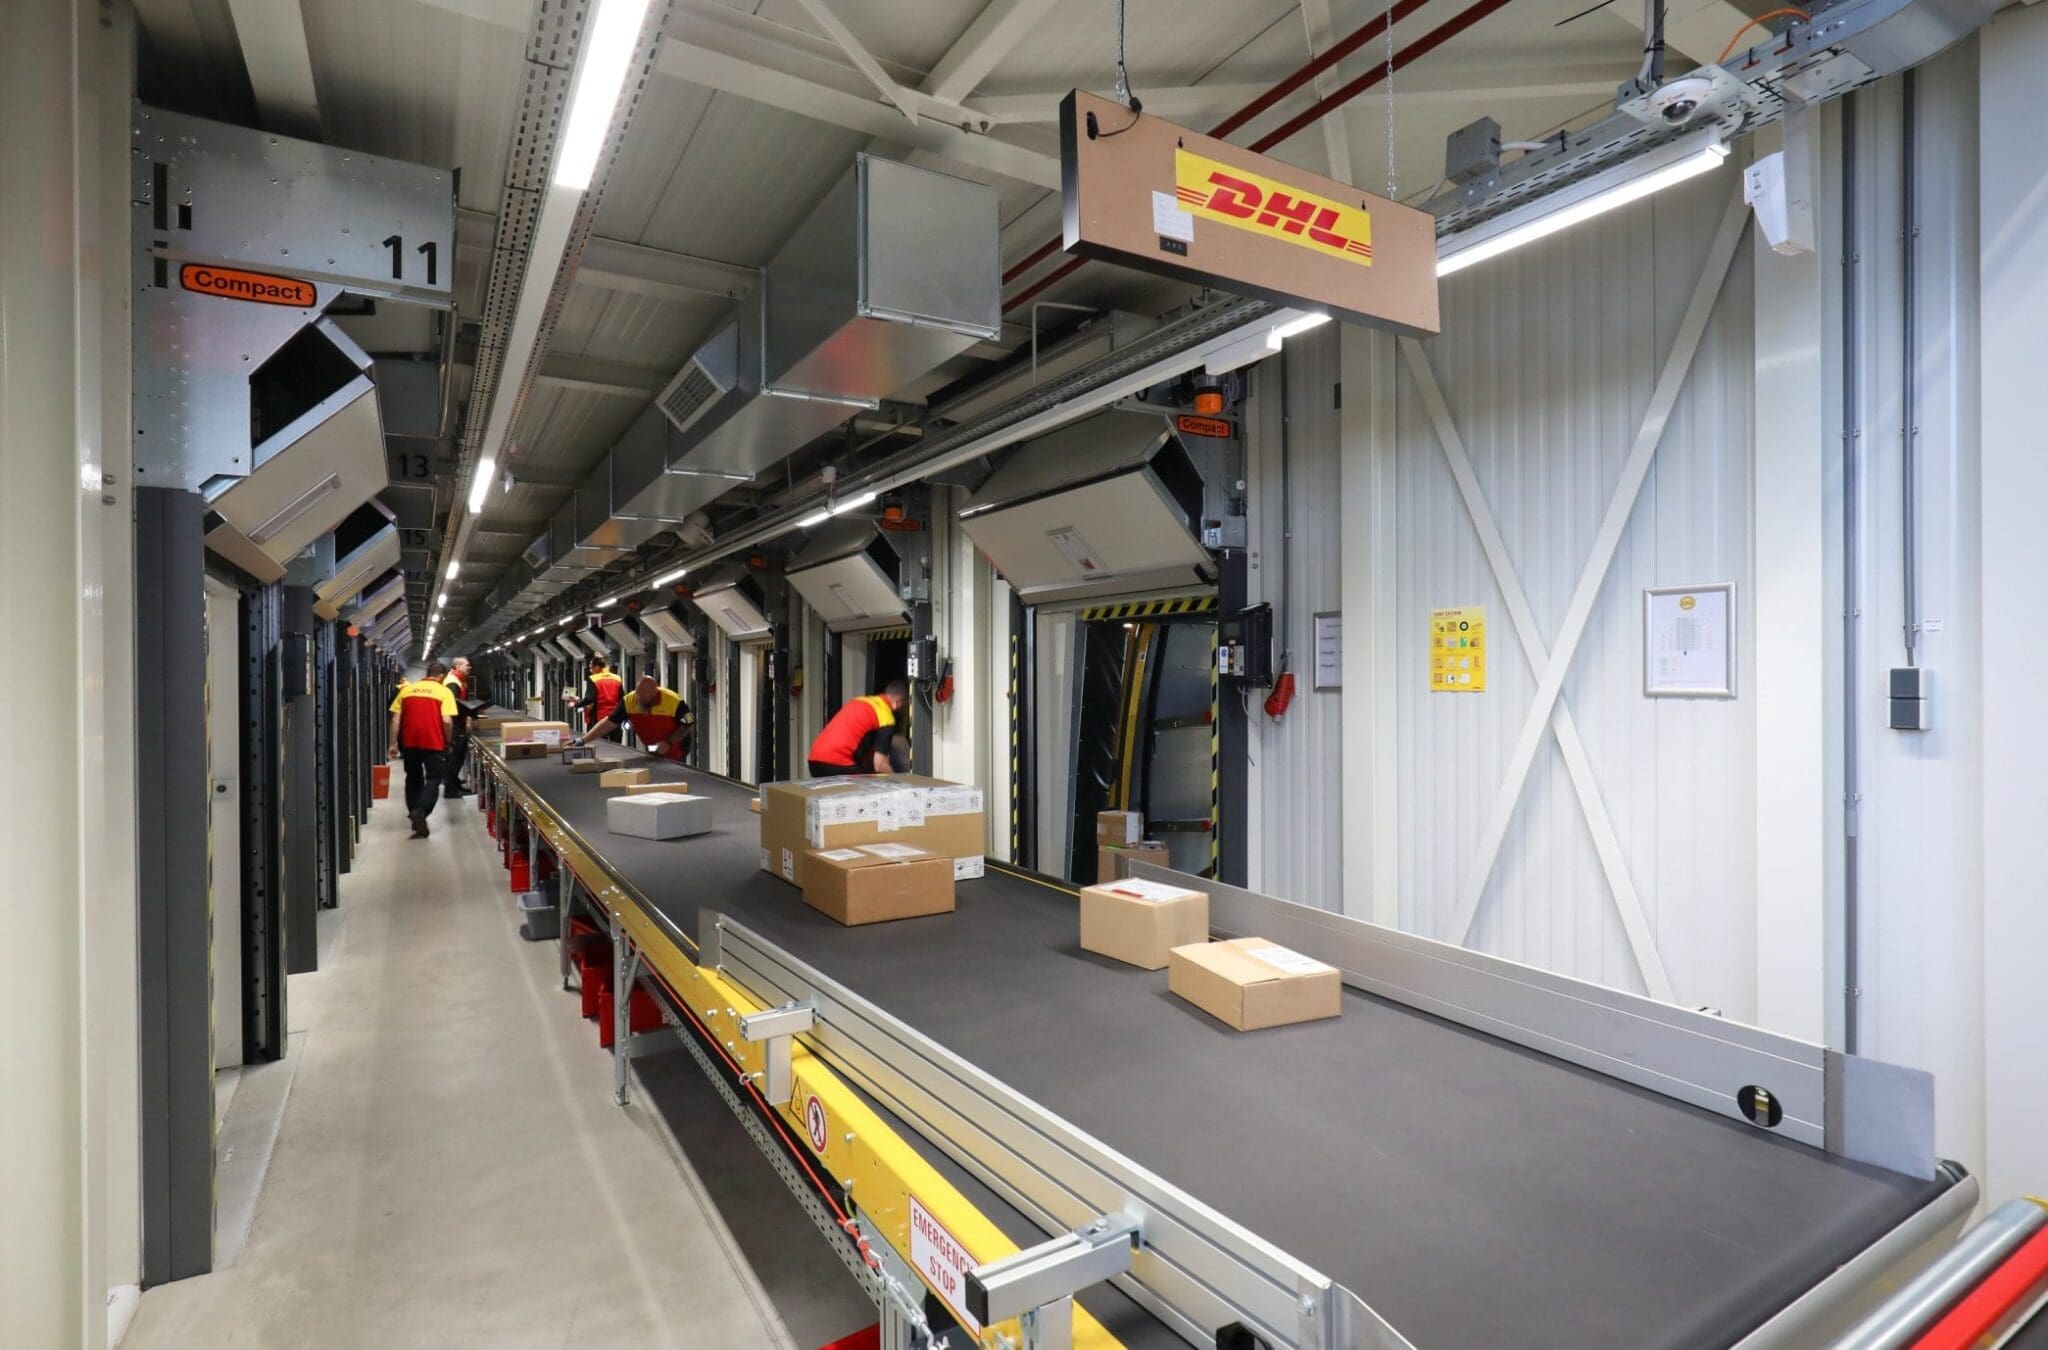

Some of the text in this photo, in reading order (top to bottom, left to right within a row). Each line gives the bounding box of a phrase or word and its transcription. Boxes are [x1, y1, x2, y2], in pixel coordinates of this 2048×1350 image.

[1205, 171, 1349, 250] DHL
[383, 235, 437, 286] 11
[194, 270, 303, 301] Compact
[1183, 418, 1227, 435] Compact
[398, 454, 429, 478] 13
[404, 530, 425, 545] 15
[929, 1256, 956, 1295] STOP
